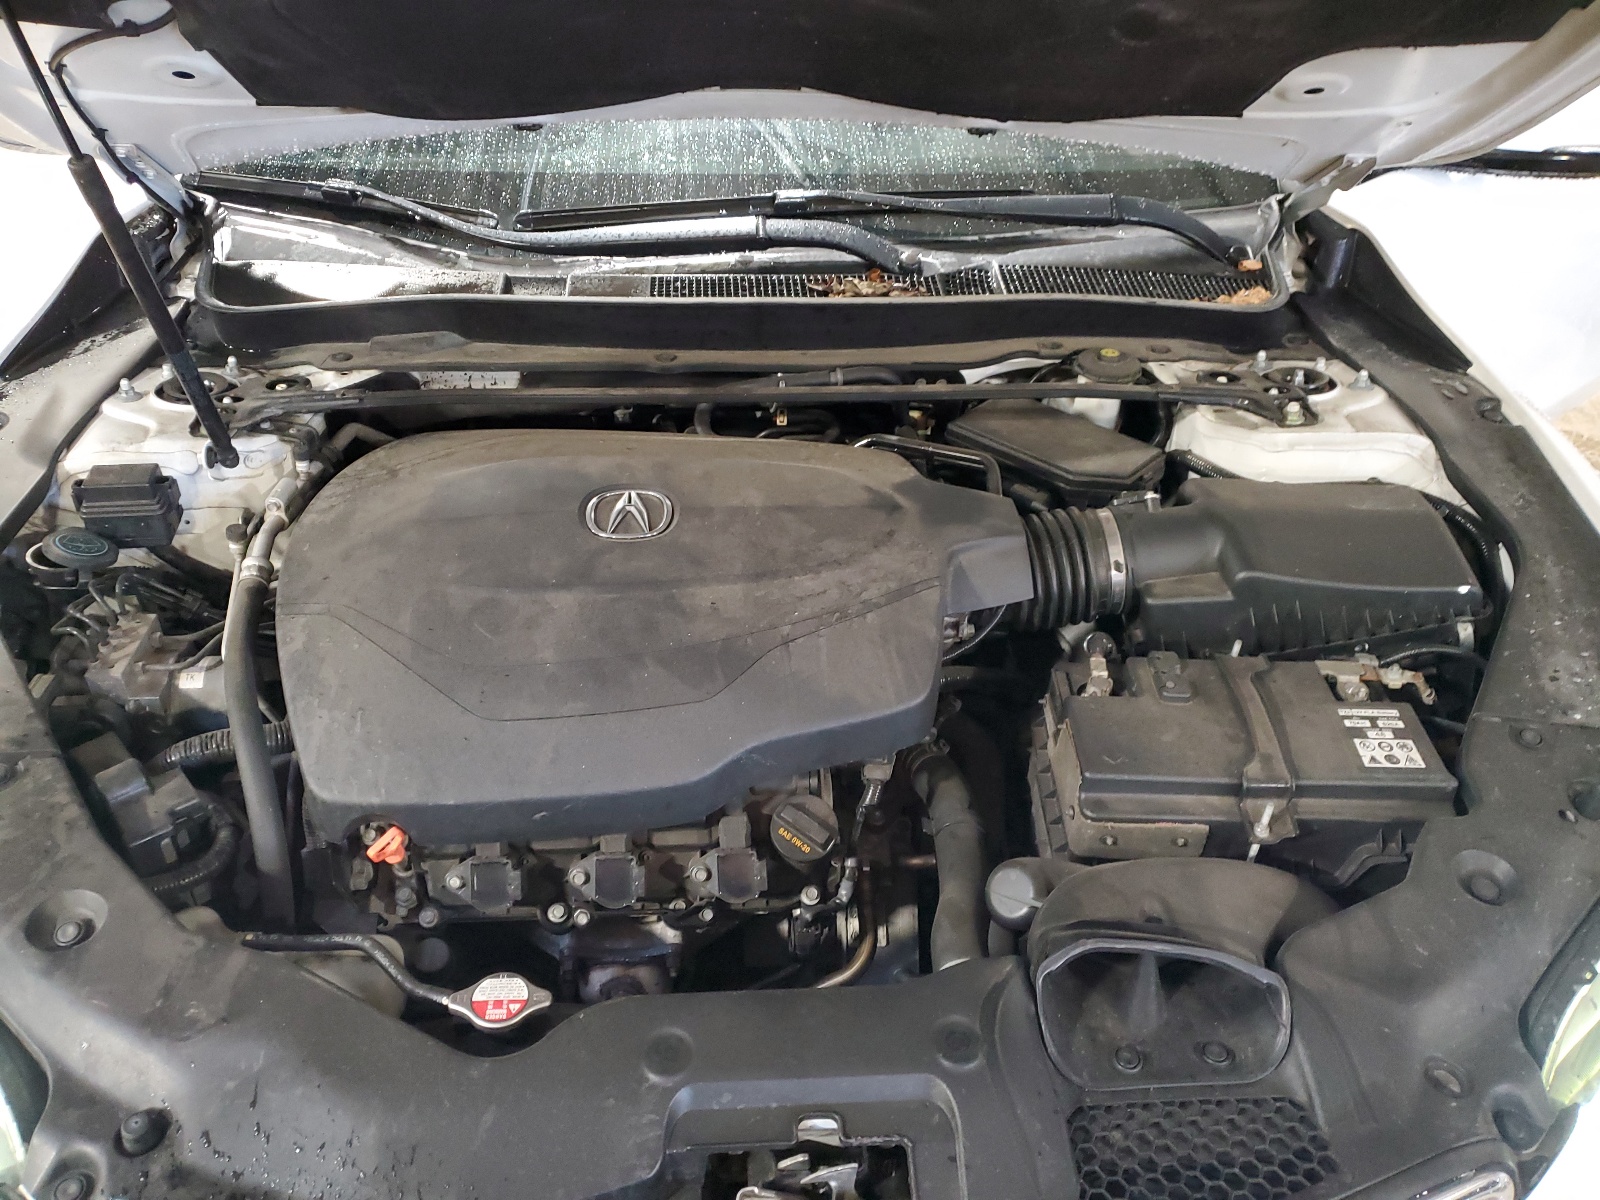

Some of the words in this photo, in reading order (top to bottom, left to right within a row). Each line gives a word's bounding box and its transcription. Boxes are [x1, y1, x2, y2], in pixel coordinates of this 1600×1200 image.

[185, 673, 196, 681] TK
[778, 827, 793, 841] SAE
[791, 836, 811, 854] 0W-20
